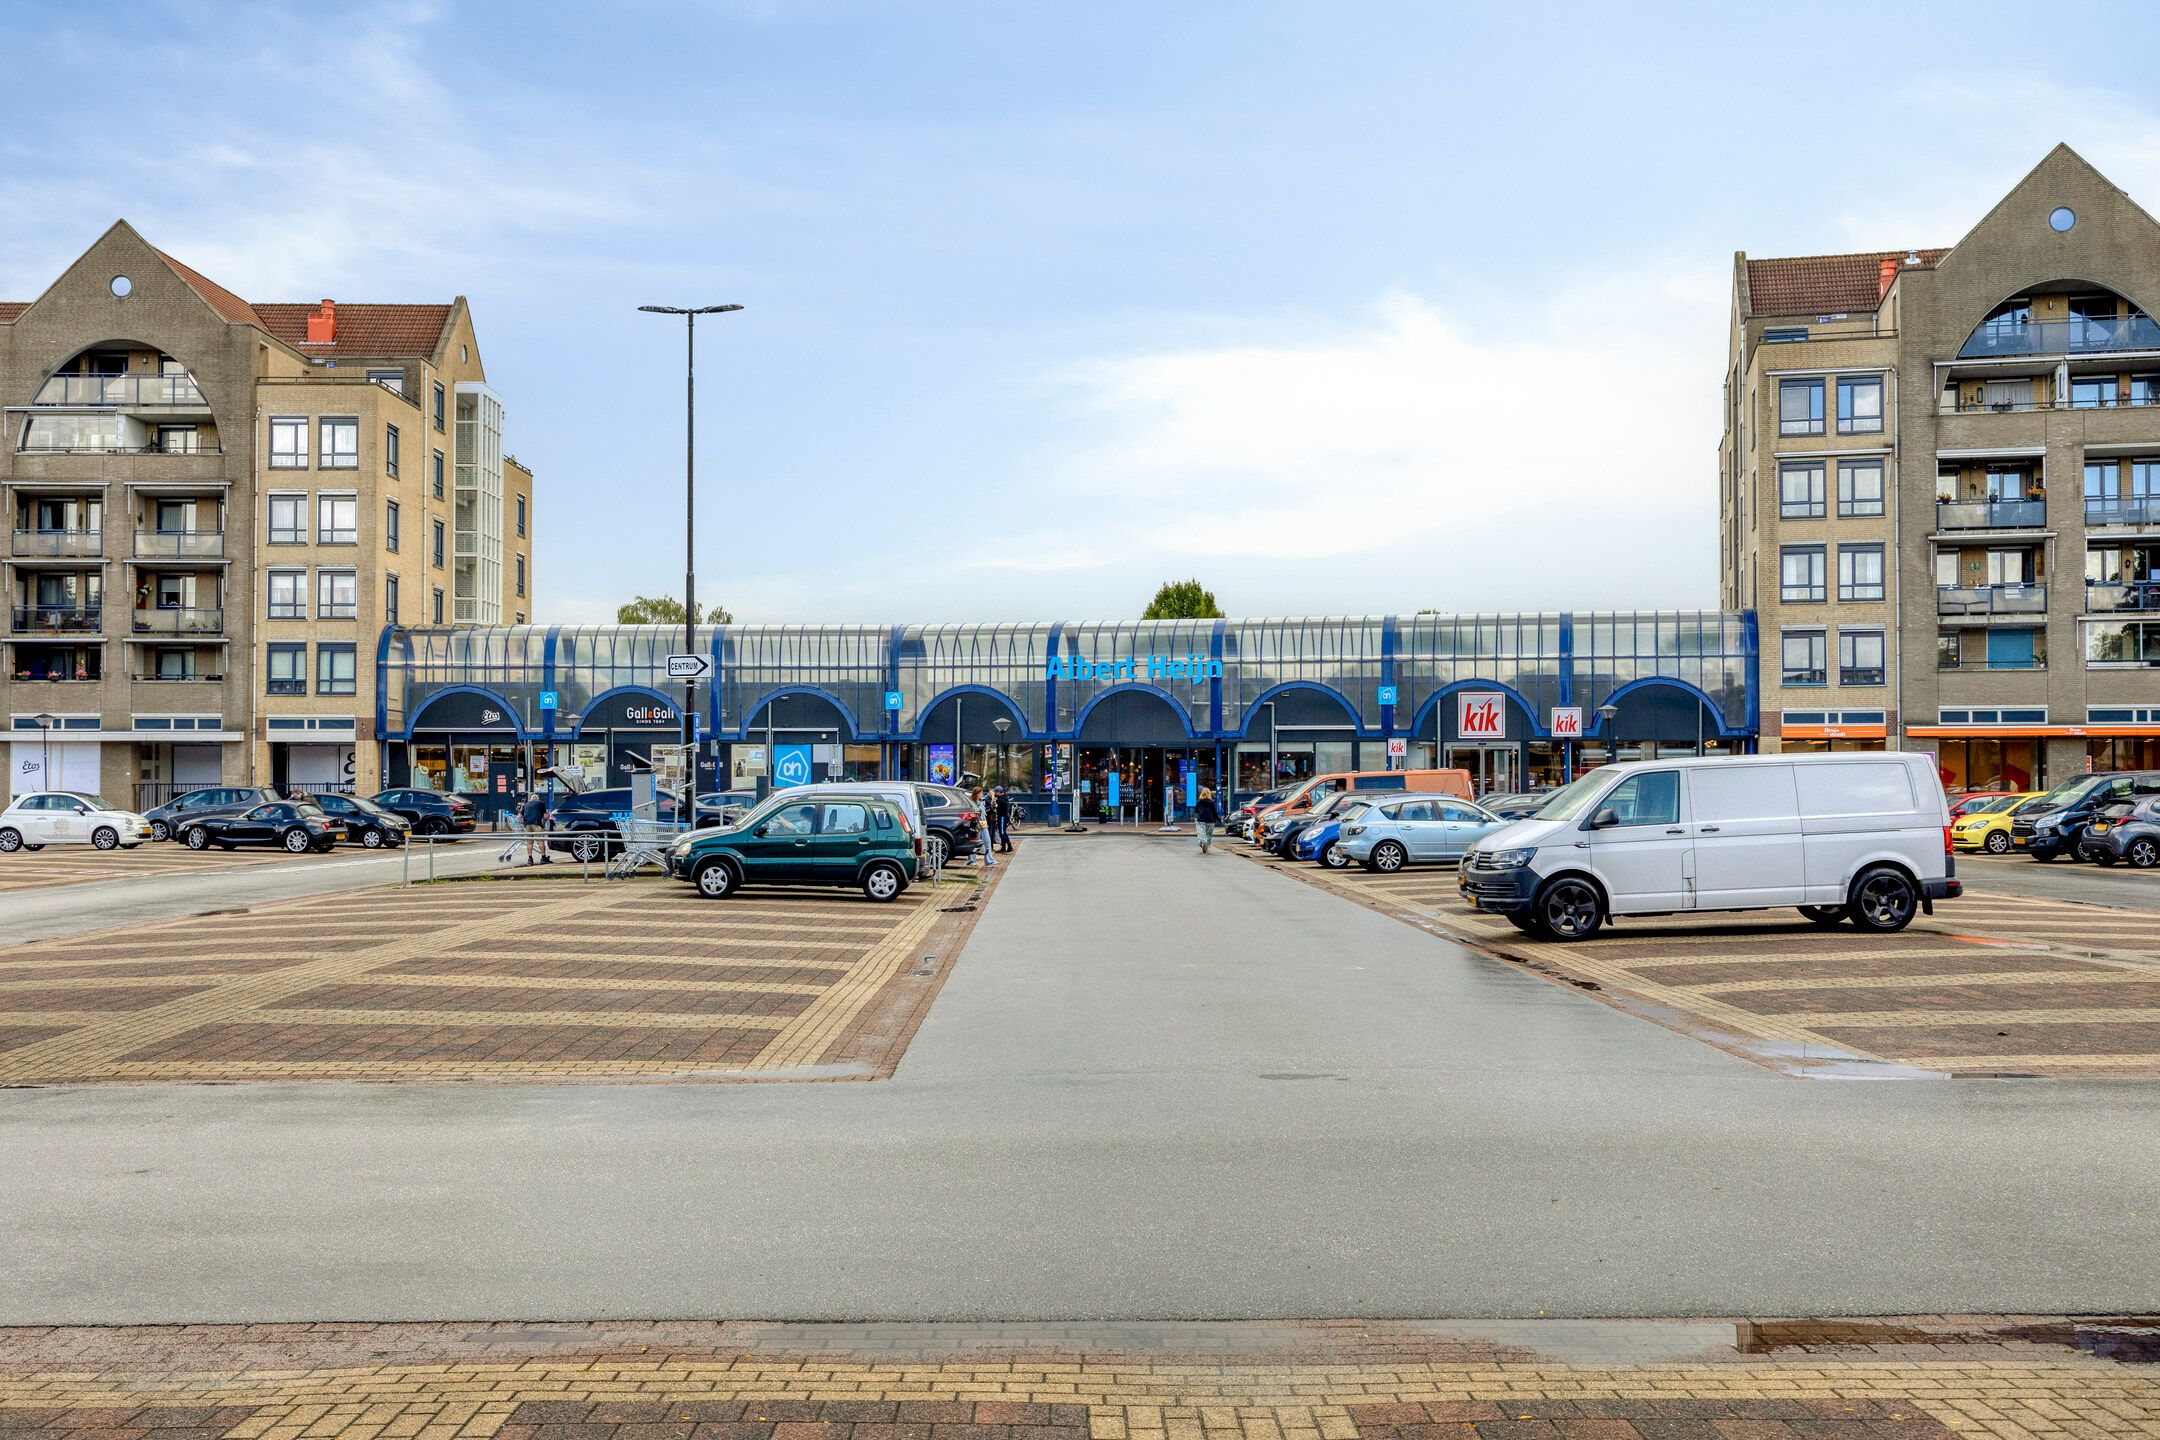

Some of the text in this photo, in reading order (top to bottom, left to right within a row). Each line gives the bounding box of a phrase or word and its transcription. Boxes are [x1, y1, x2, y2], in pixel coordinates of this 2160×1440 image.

[670, 662, 698, 670] CENTRUM
[1047, 653, 1223, 685] Albert Heijn
[482, 709, 500, 724] Etos
[22, 760, 40, 774] Etos
